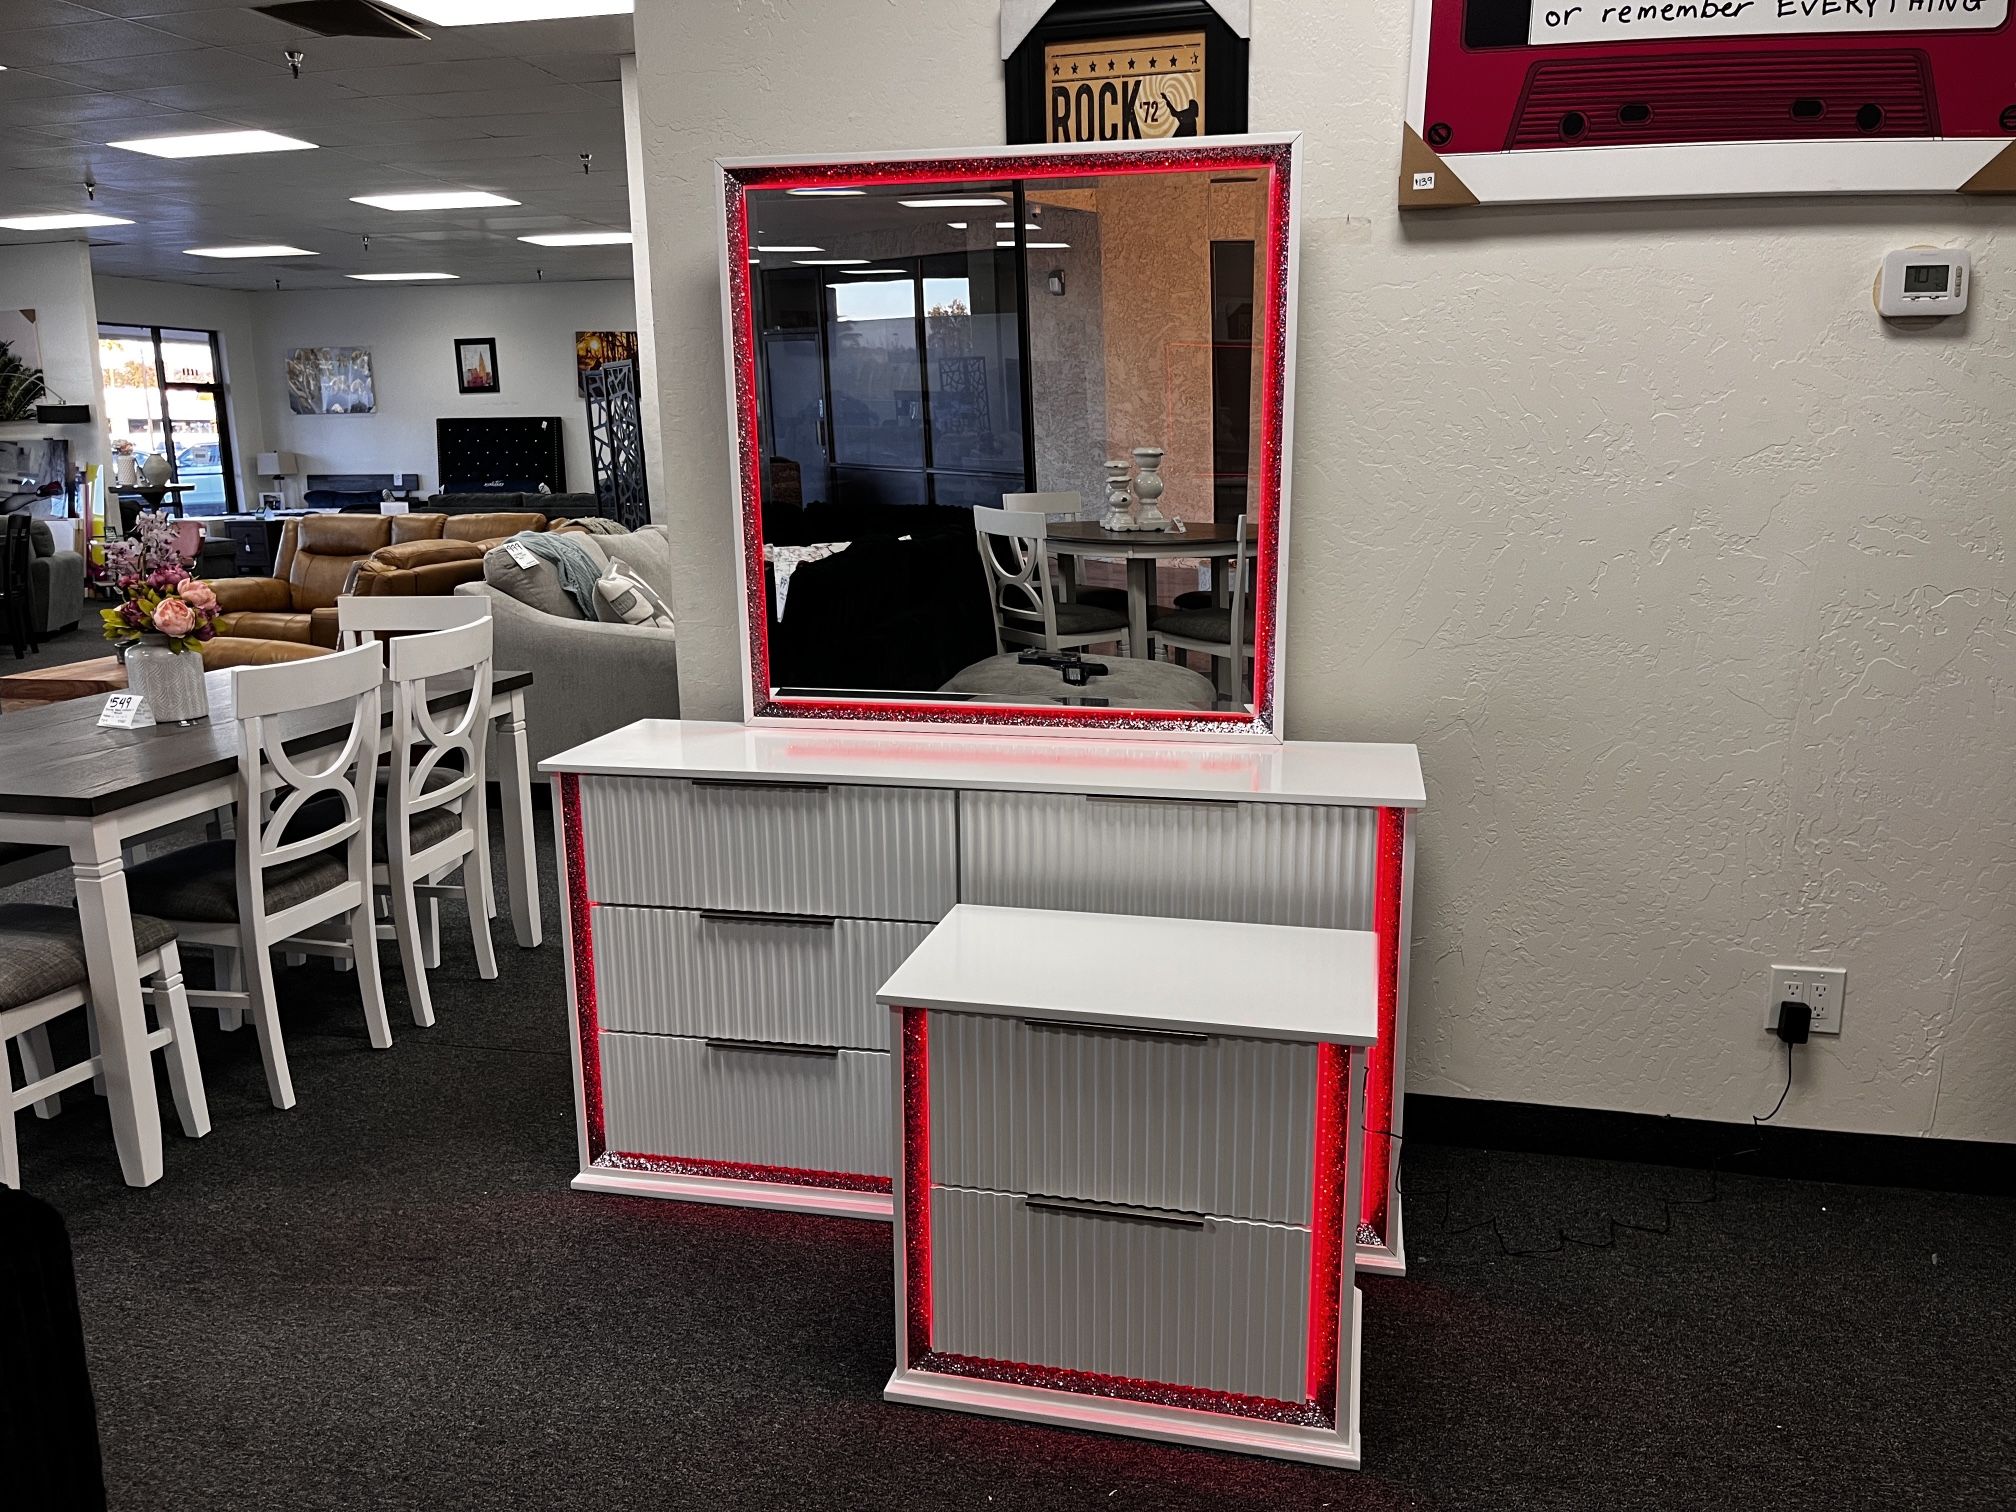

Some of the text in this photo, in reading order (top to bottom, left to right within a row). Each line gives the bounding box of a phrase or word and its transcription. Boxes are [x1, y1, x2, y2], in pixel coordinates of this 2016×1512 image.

[1545, 6, 1582, 27] or
[1601, 0, 1755, 23] remember
[1052, 80, 1142, 143] ROCK
